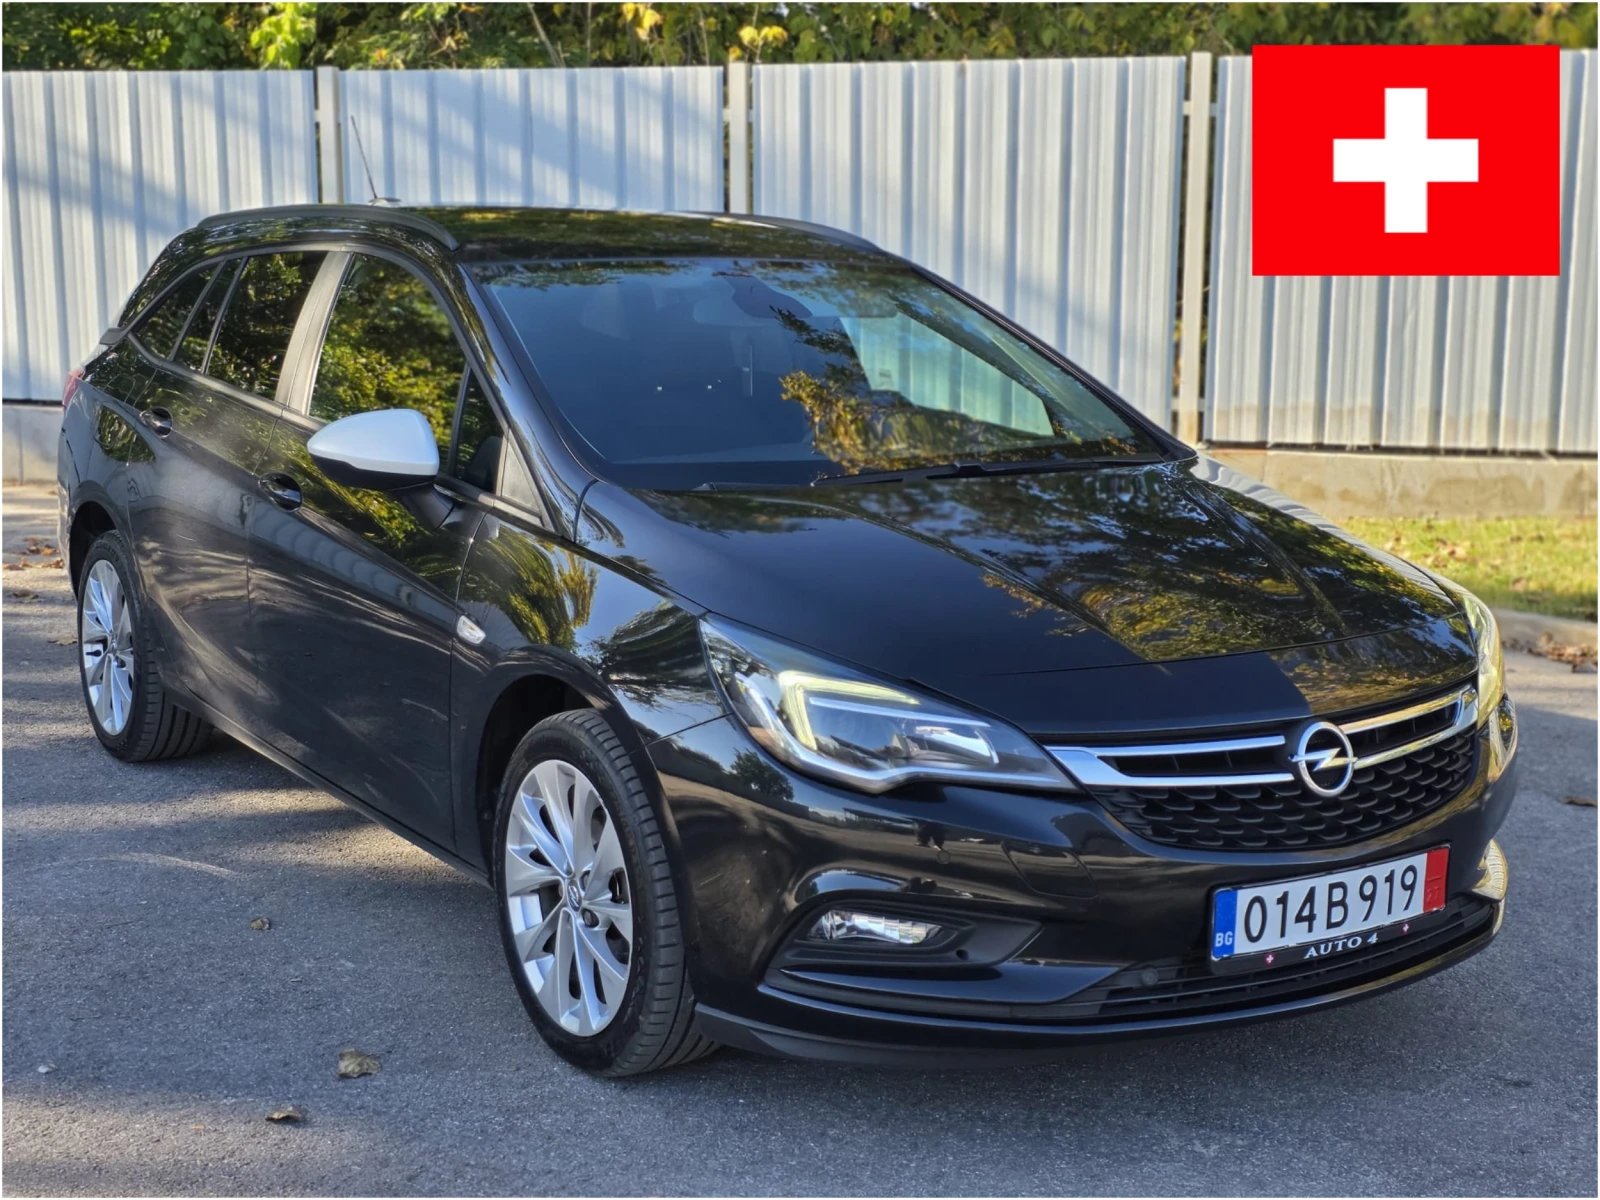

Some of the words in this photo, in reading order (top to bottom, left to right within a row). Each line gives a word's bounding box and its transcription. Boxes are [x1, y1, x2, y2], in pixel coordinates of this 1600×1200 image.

[1215, 931, 1233, 947] BG
[1304, 936, 1362, 959] AUTO
[1367, 932, 1379, 944] 4
